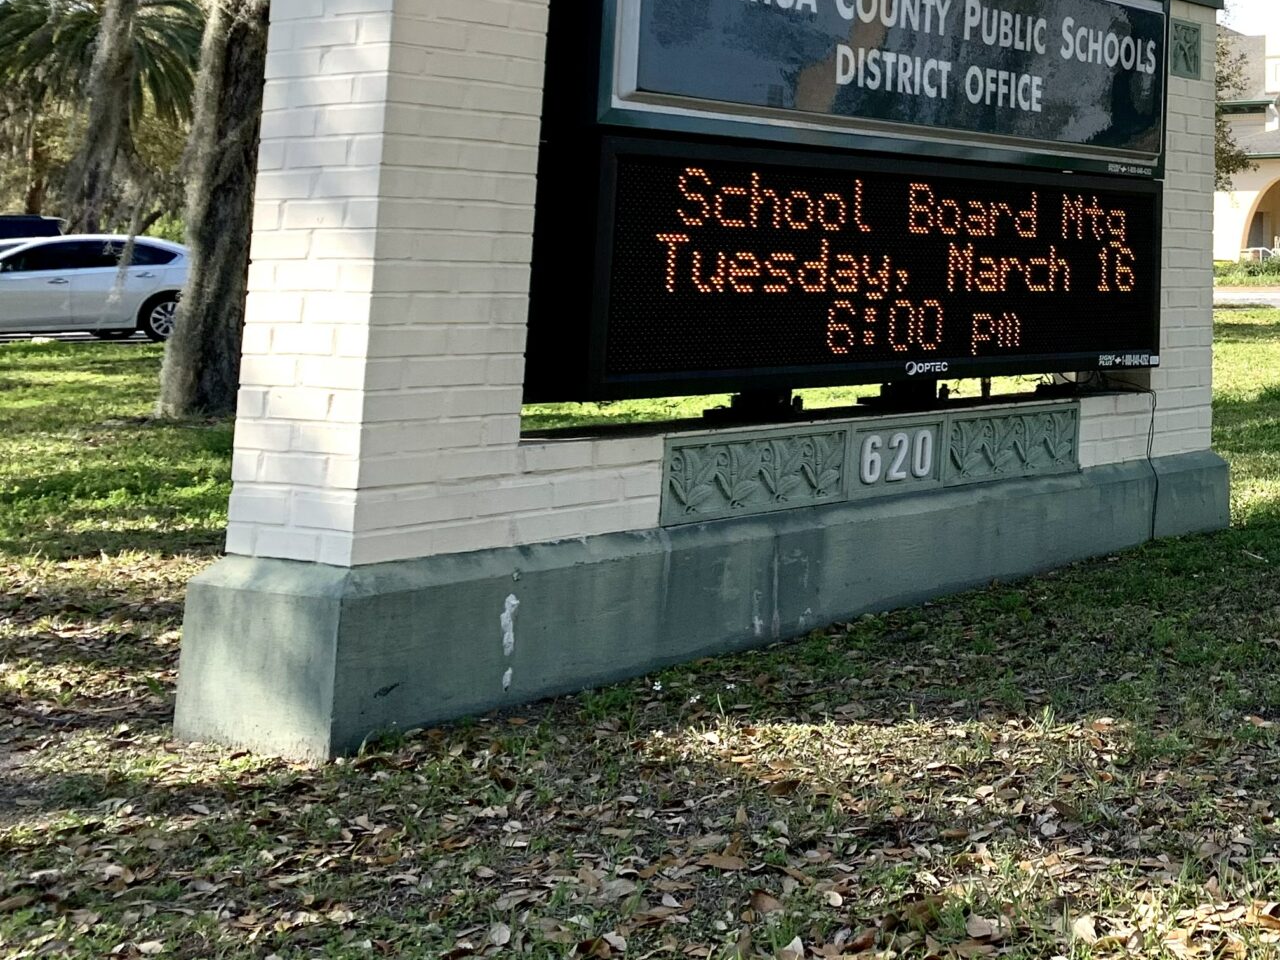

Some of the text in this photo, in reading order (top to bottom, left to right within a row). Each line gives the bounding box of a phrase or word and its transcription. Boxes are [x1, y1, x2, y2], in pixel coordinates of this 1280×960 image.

[1060, 16, 1156, 74] SCHOOLS
[835, 43, 1043, 112] DISTRICT OFFICE
[677, 167, 1126, 248] School Board Mtg
[655, 233, 1135, 300] Tuesday, March 16
[826, 299, 1021, 355] 6:00 pm
[915, 361, 949, 373] OPTEC
[861, 429, 933, 484] 620
